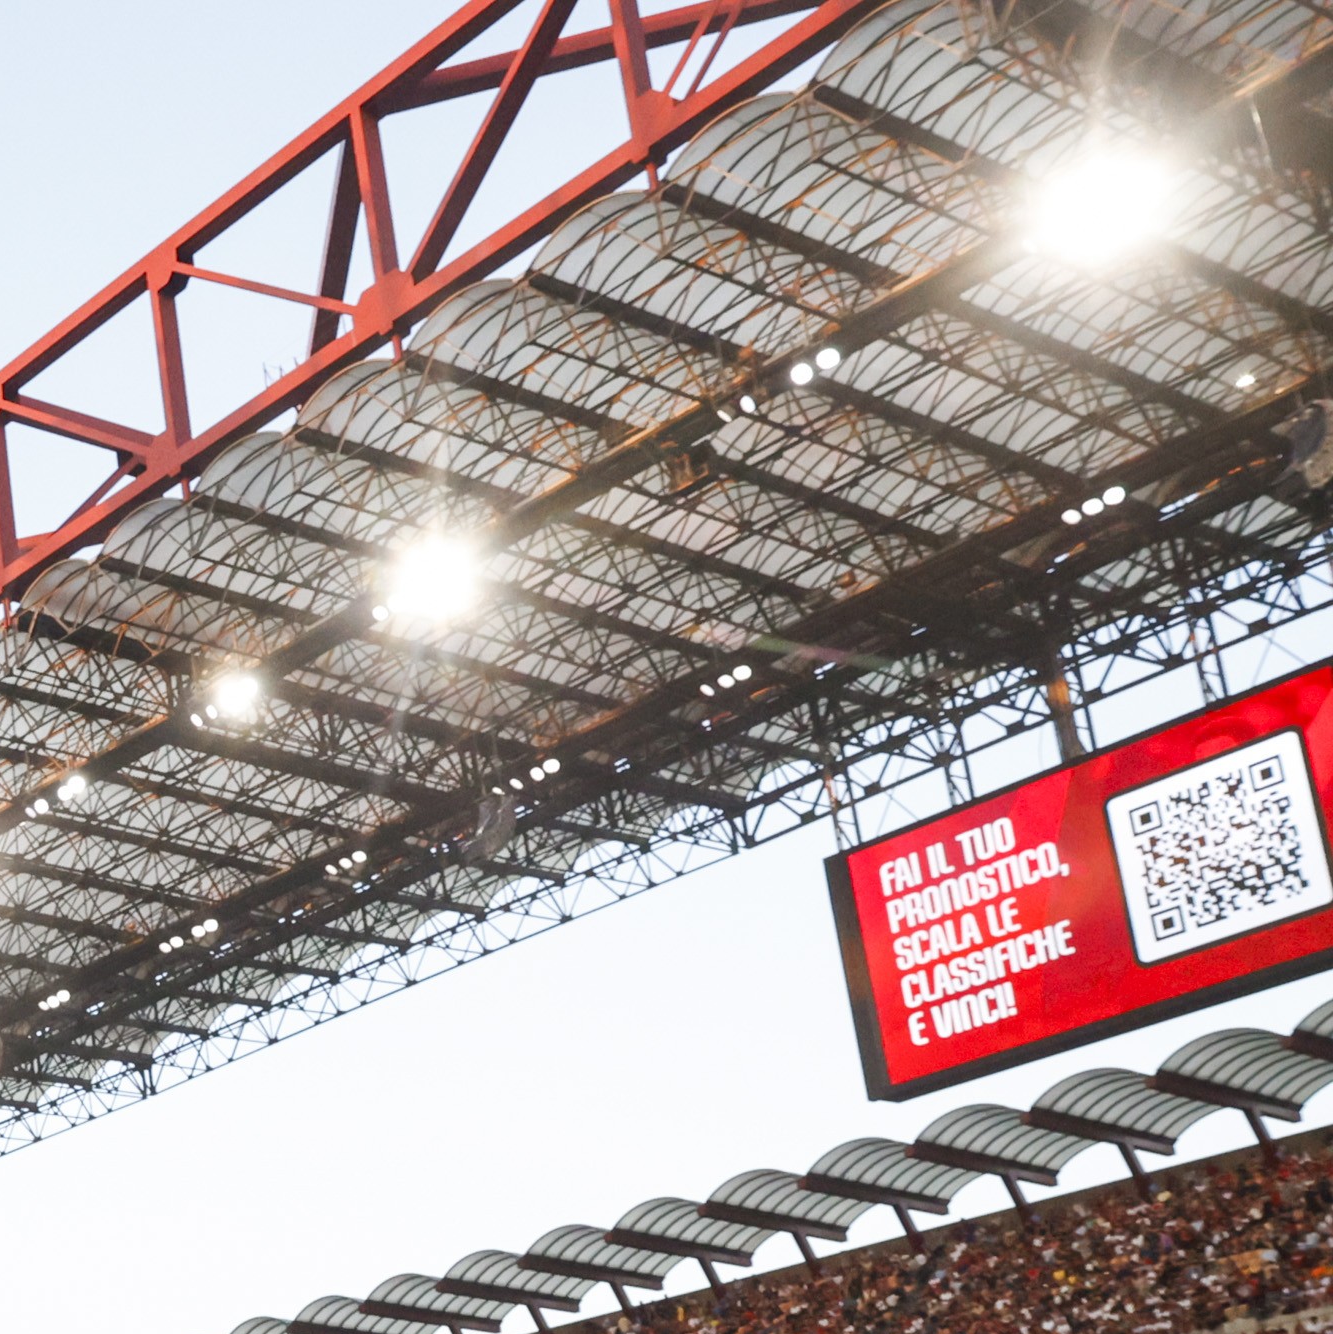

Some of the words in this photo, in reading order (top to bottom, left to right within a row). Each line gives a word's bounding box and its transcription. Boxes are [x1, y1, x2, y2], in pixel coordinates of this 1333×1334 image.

[879, 849, 925, 896] FAI
[926, 844, 954, 880] IL
[955, 817, 1016, 866] TUO
[886, 842, 1070, 933] PRONOSTICO,
[893, 916, 983, 971] SCALA
[985, 897, 1022, 937] LE
[901, 919, 1076, 1008] CLASSIFICHE
[908, 1013, 929, 1046] E
[931, 982, 1018, 1039] VINCI!
